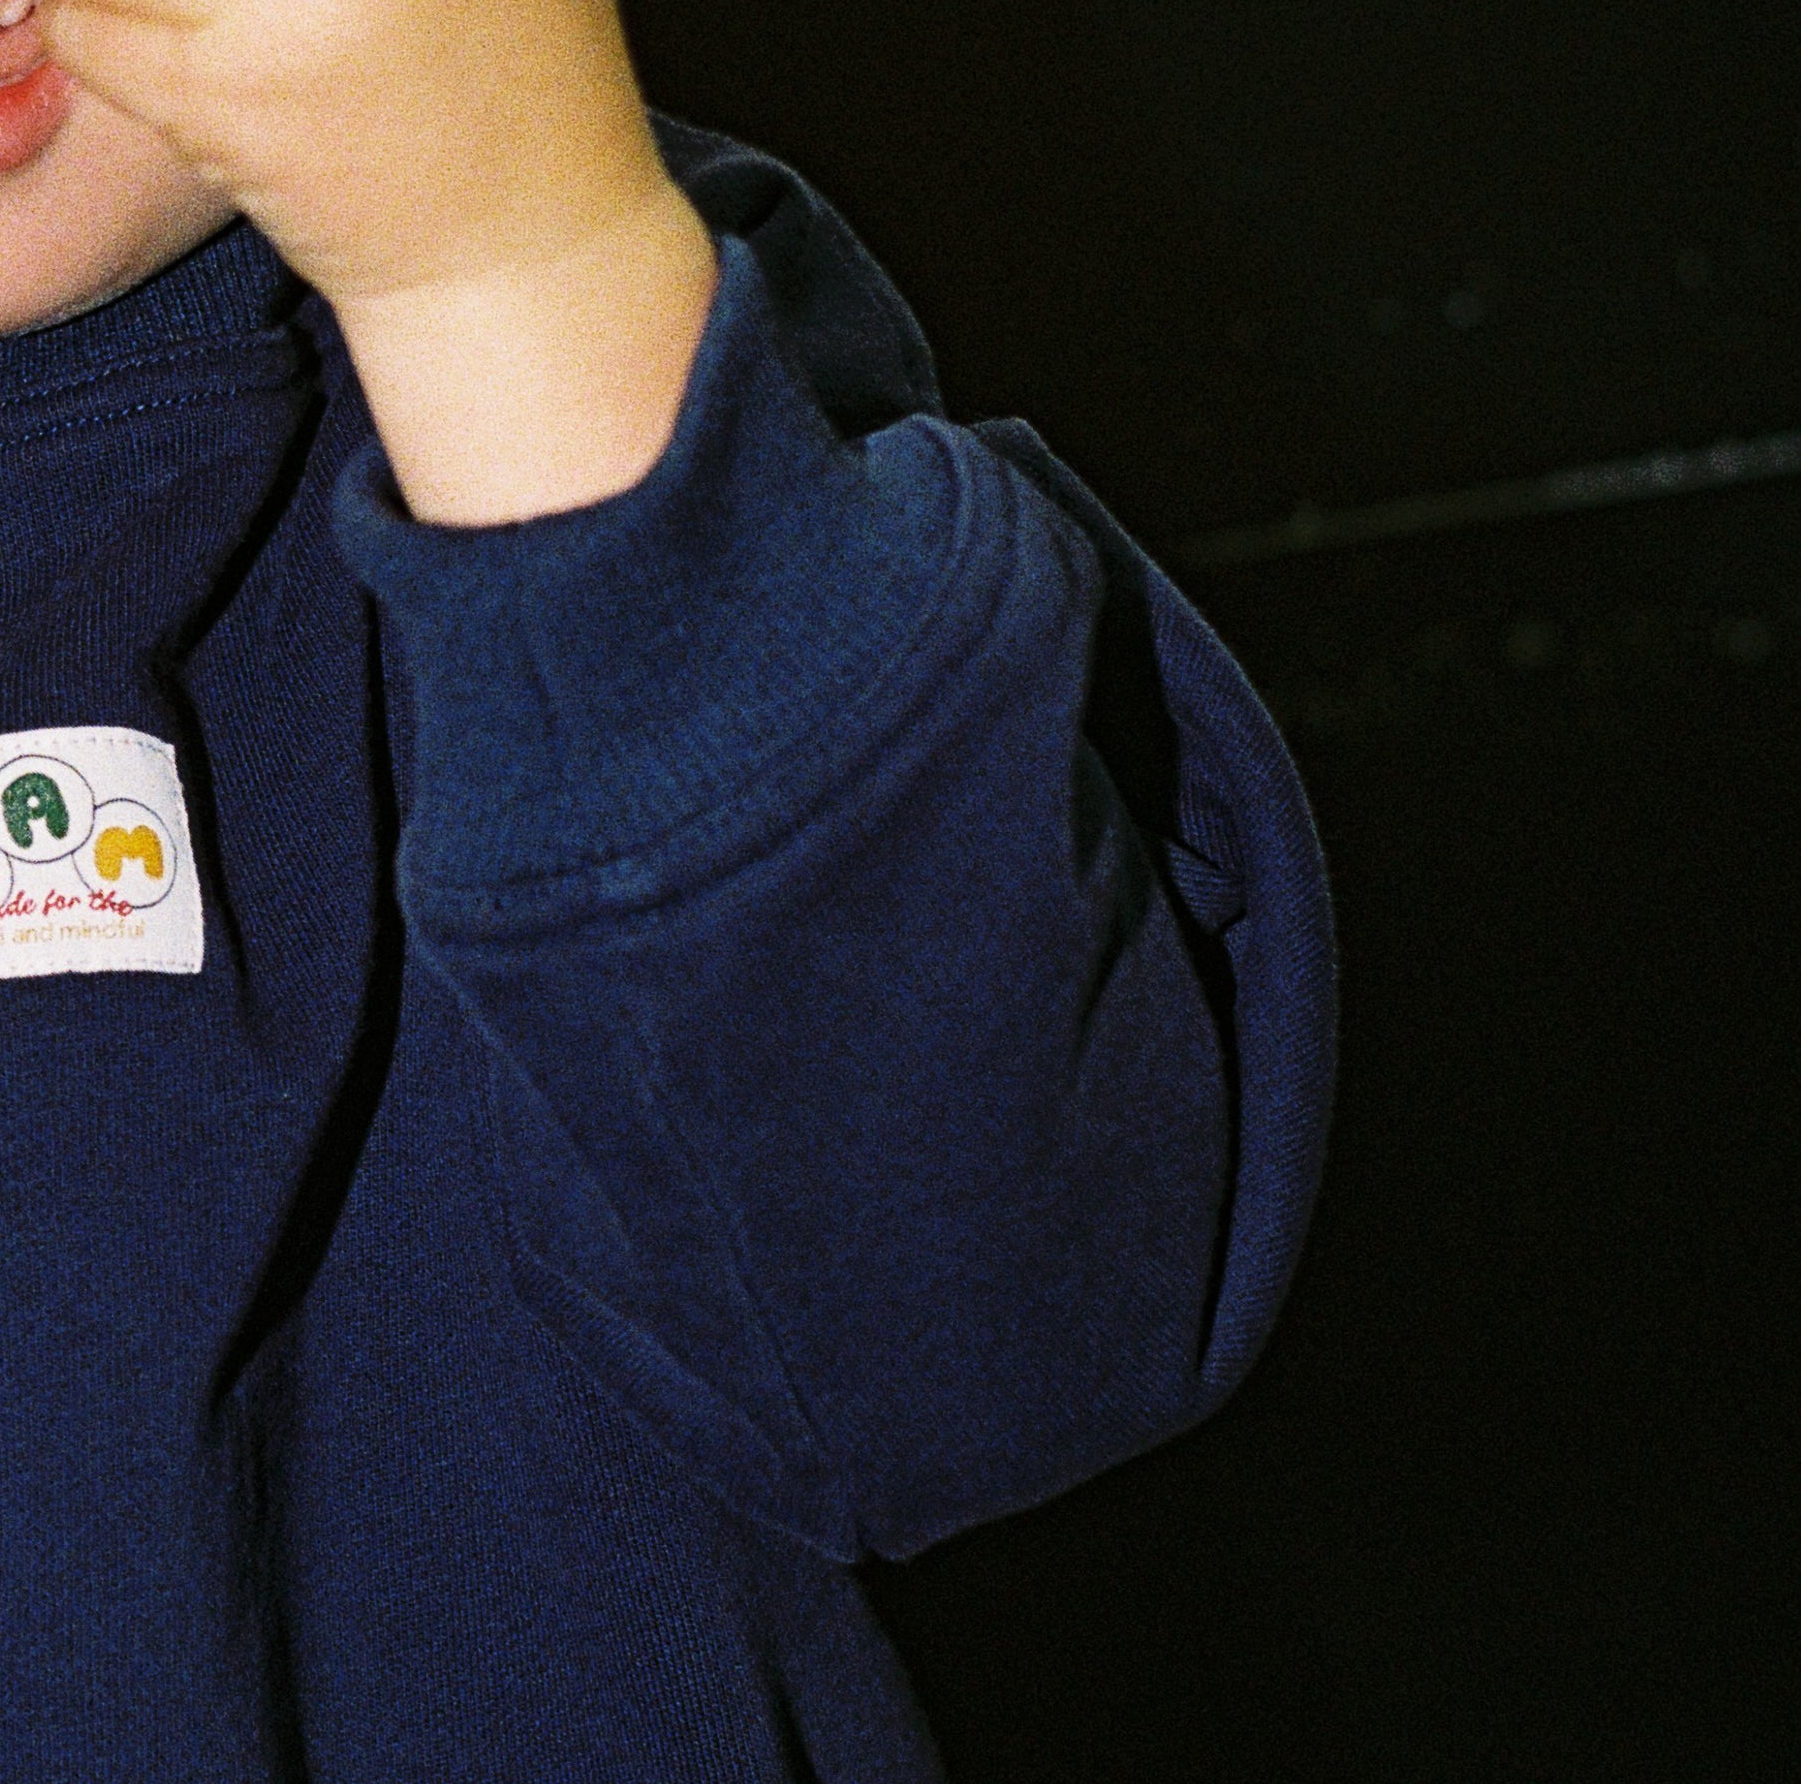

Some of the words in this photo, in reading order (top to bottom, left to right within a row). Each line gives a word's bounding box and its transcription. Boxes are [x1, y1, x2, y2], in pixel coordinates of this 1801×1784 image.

[42, 888, 81, 917] for
[88, 888, 133, 917] the
[12, 922, 53, 945] and
